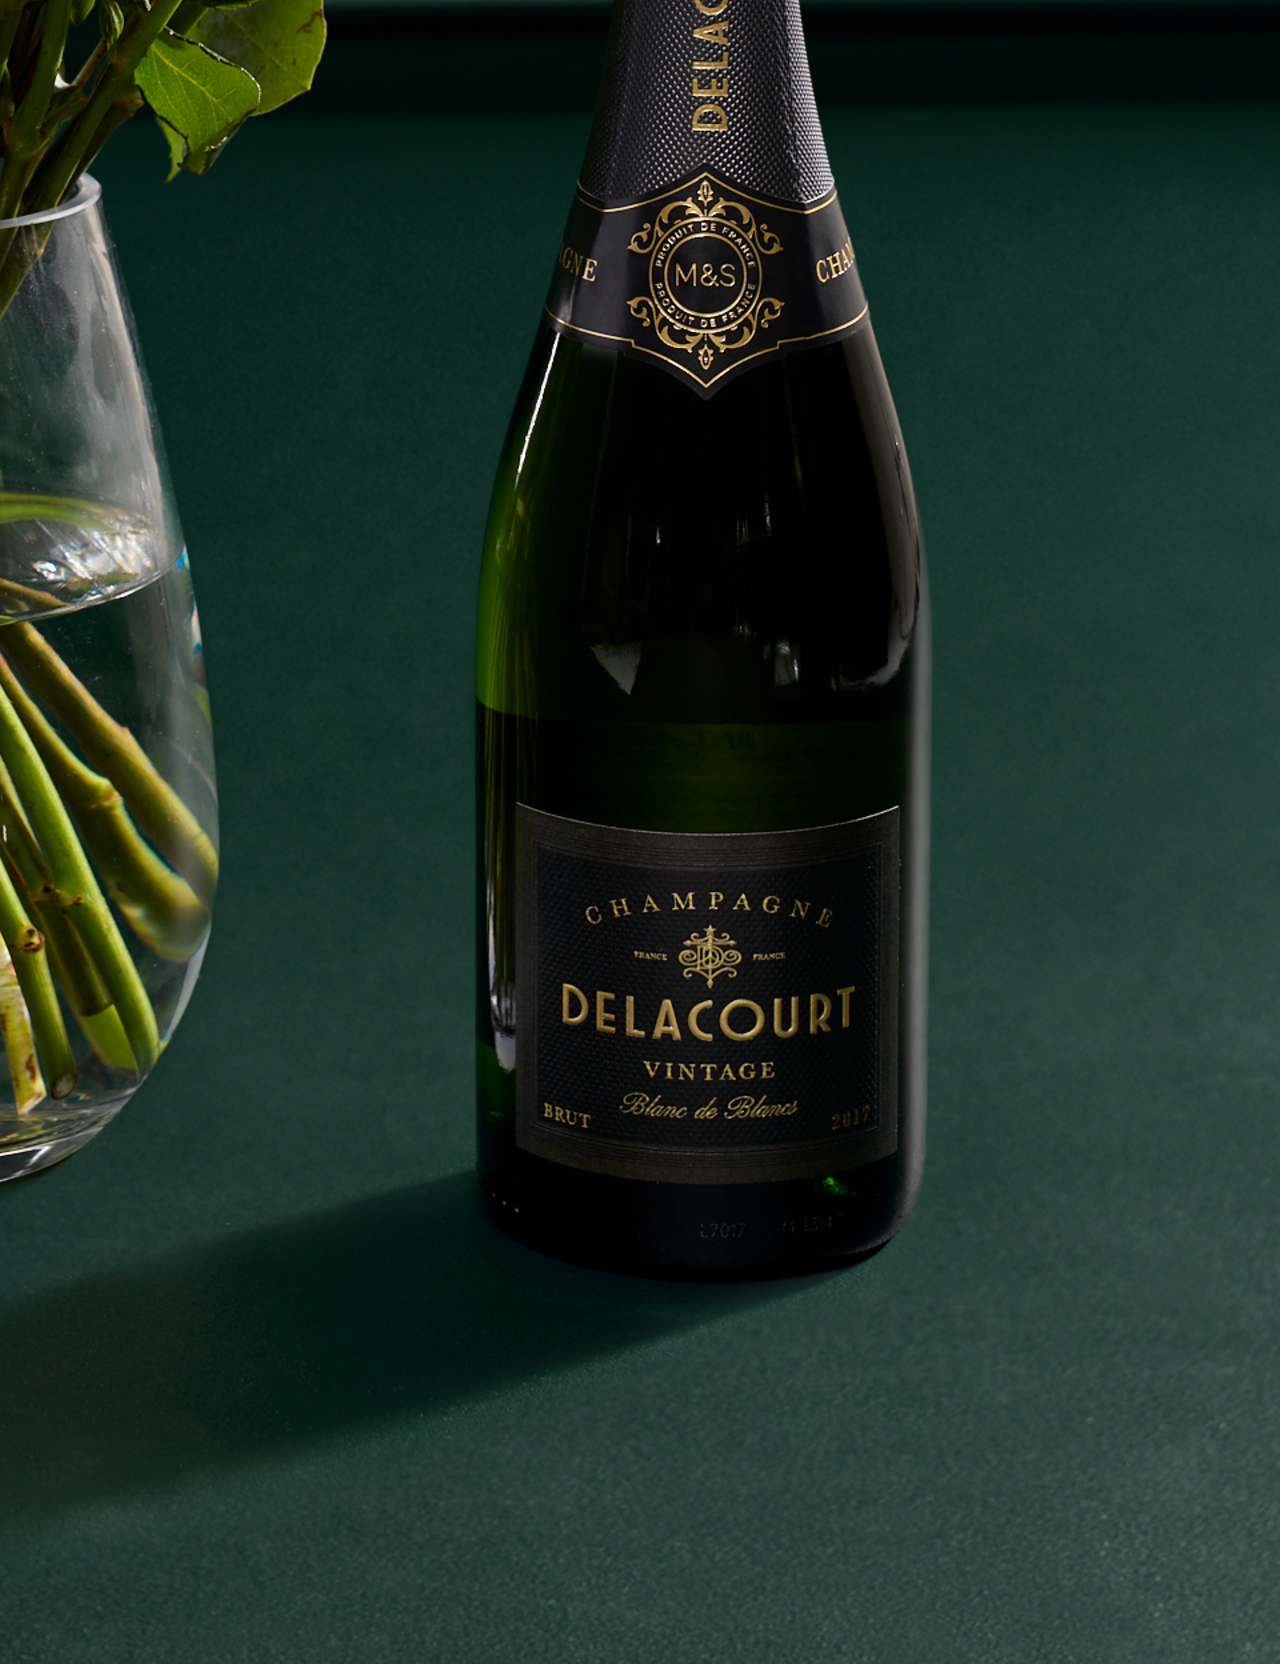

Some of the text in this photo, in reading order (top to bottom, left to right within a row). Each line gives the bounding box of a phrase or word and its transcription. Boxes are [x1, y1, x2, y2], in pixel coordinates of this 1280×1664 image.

[655, 222, 757, 268] PRODUIT DE FRANCE
[674, 262, 736, 288] M&S
[655, 281, 757, 328] PRODUIT DE FRANCE
[584, 890, 834, 928] CHAMPAGNE
[632, 949, 668, 961] FRANCE
[751, 951, 786, 961] FRANCE
[561, 982, 856, 1042] DELACOURT
[641, 1059, 777, 1082] VINTAGE
[542, 1101, 592, 1129] BRUT
[618, 1091, 799, 1120] Blanc de Blancs
